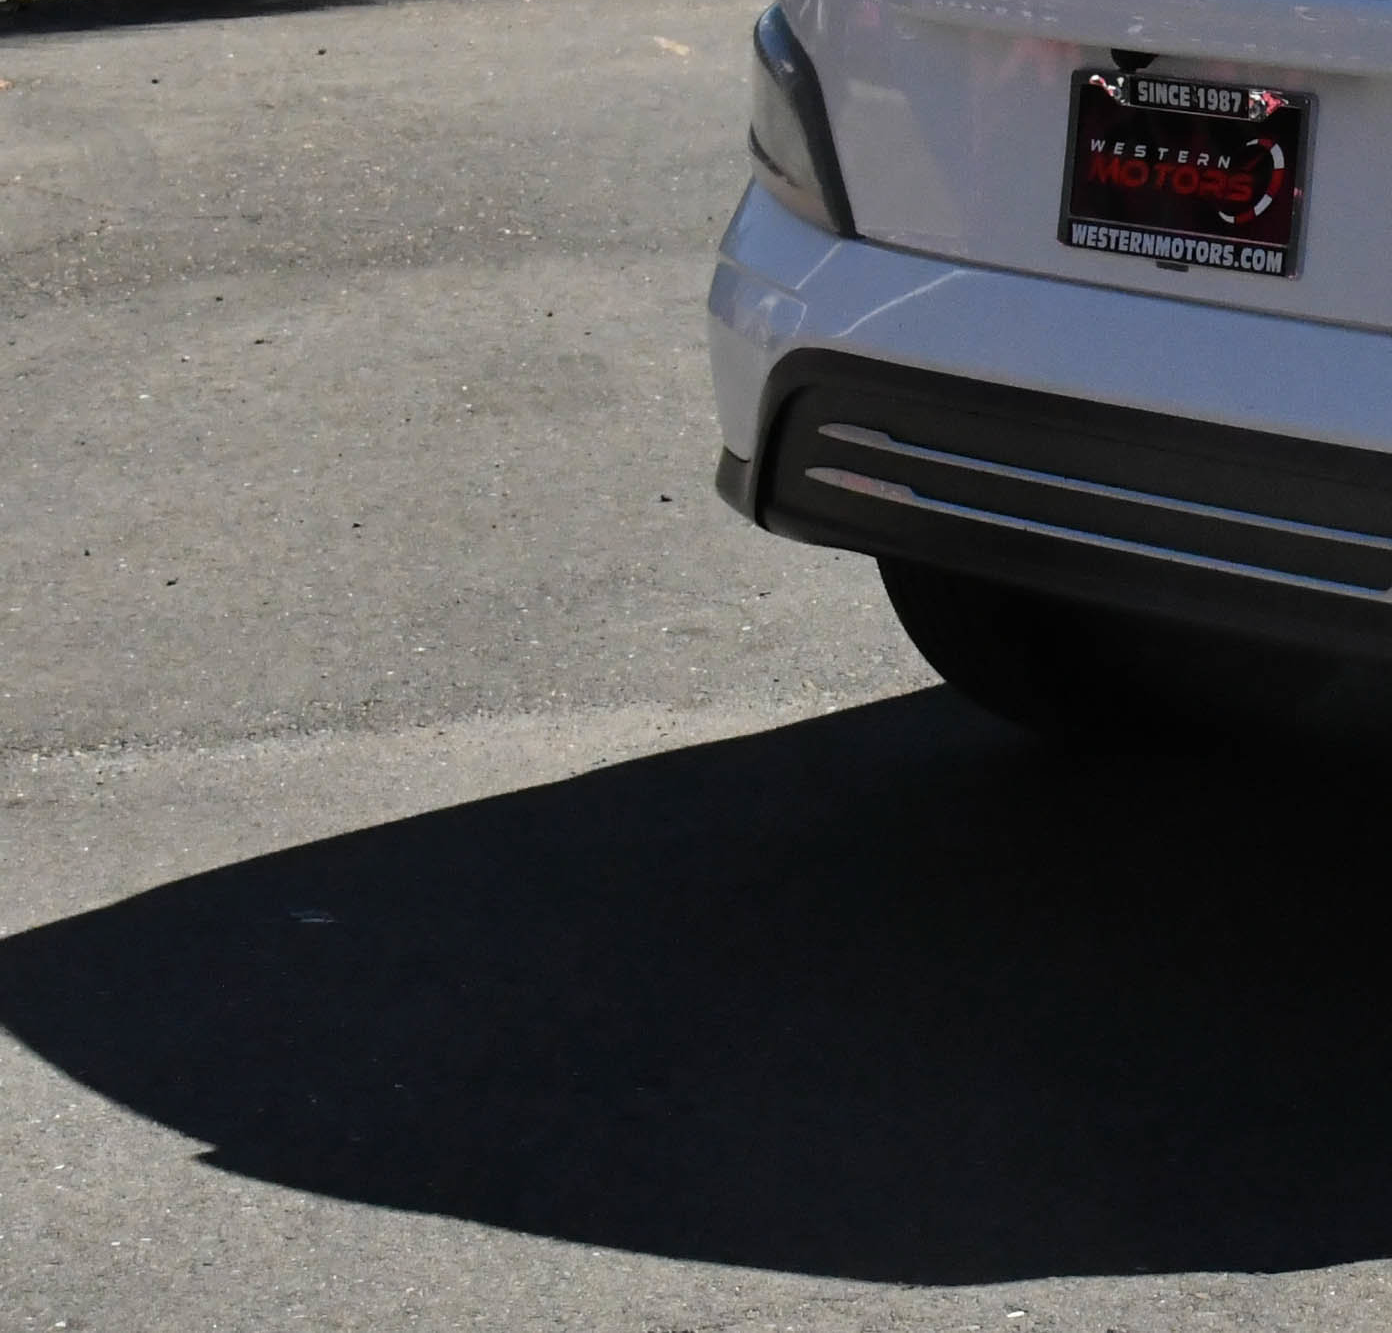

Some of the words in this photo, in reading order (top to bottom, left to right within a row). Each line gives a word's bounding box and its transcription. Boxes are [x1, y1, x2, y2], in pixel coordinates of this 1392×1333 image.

[1138, 81, 1190, 107] SINCE
[1196, 87, 1242, 113] 1987
[1091, 139, 1231, 169] WESTERN
[1087, 156, 1254, 202] MOTORS
[1072, 223, 1283, 273] WESTERNMOTORS.COM
